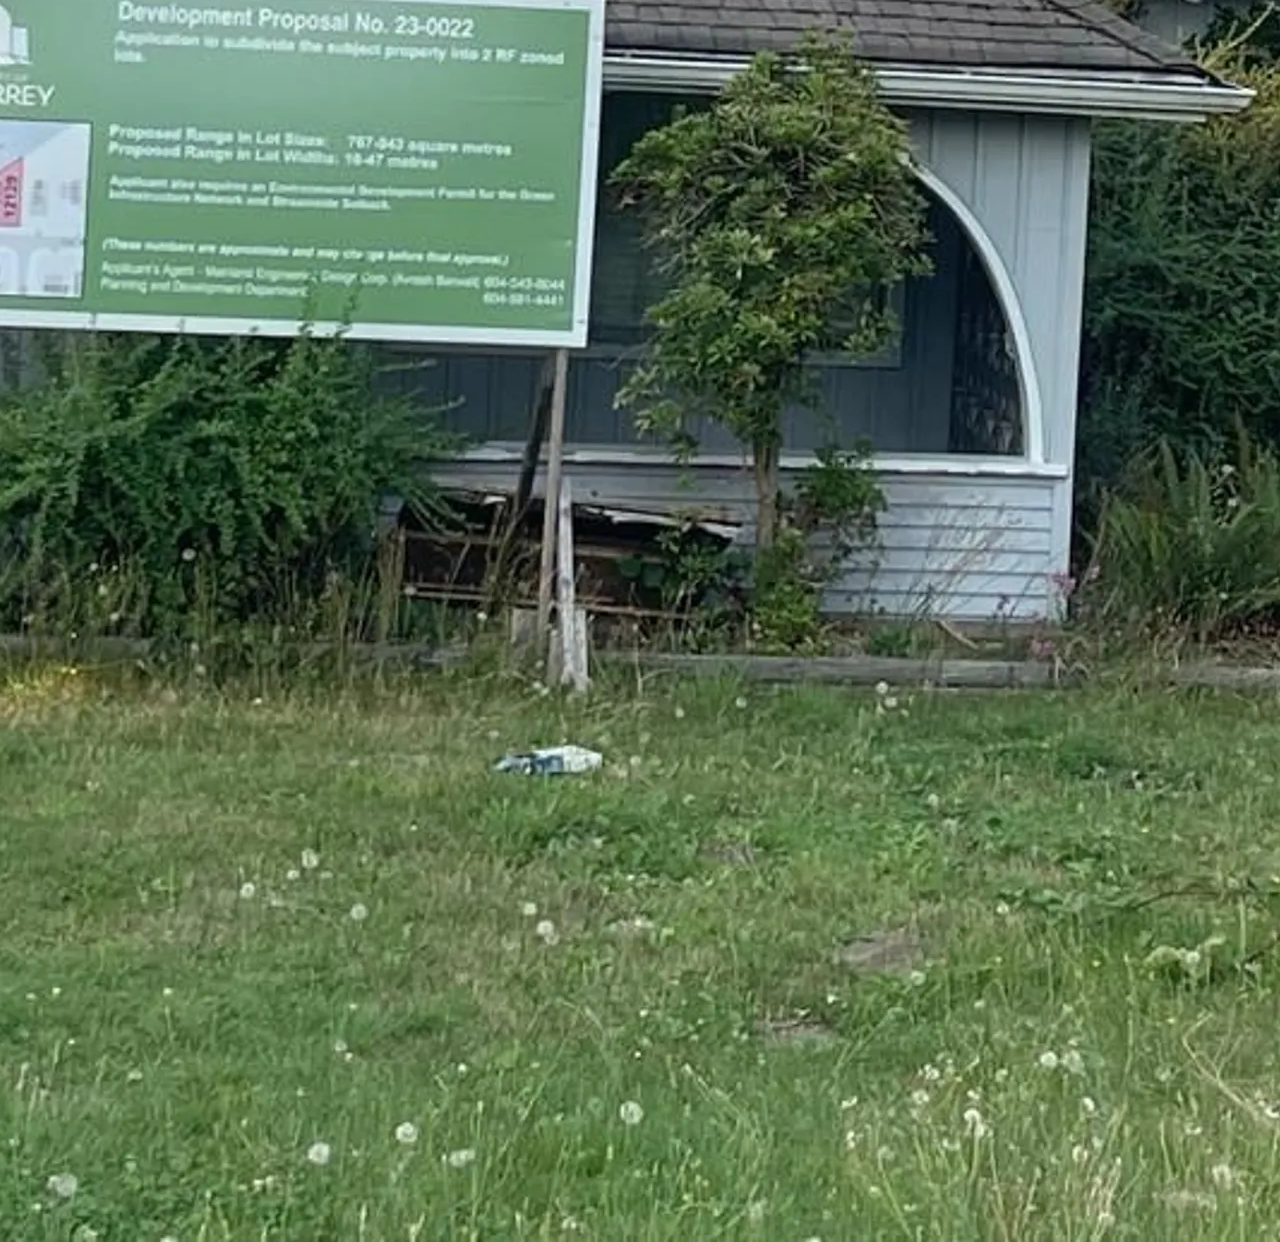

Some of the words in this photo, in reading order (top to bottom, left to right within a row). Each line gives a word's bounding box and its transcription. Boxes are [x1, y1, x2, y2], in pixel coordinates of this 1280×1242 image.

[119, 0, 252, 29] Development
[258, 7, 349, 34] Proposal
[355, 12, 389, 34] No.
[394, 15, 474, 38] 23-0022
[384, 44, 447, 64] property
[108, 124, 182, 142] Proposed
[186, 127, 234, 145] Range
[256, 131, 280, 146] Lot
[408, 140, 458, 157] square
[108, 141, 181, 159] Proposed
[184, 145, 233, 163] Range
[255, 148, 280, 163] Lot
